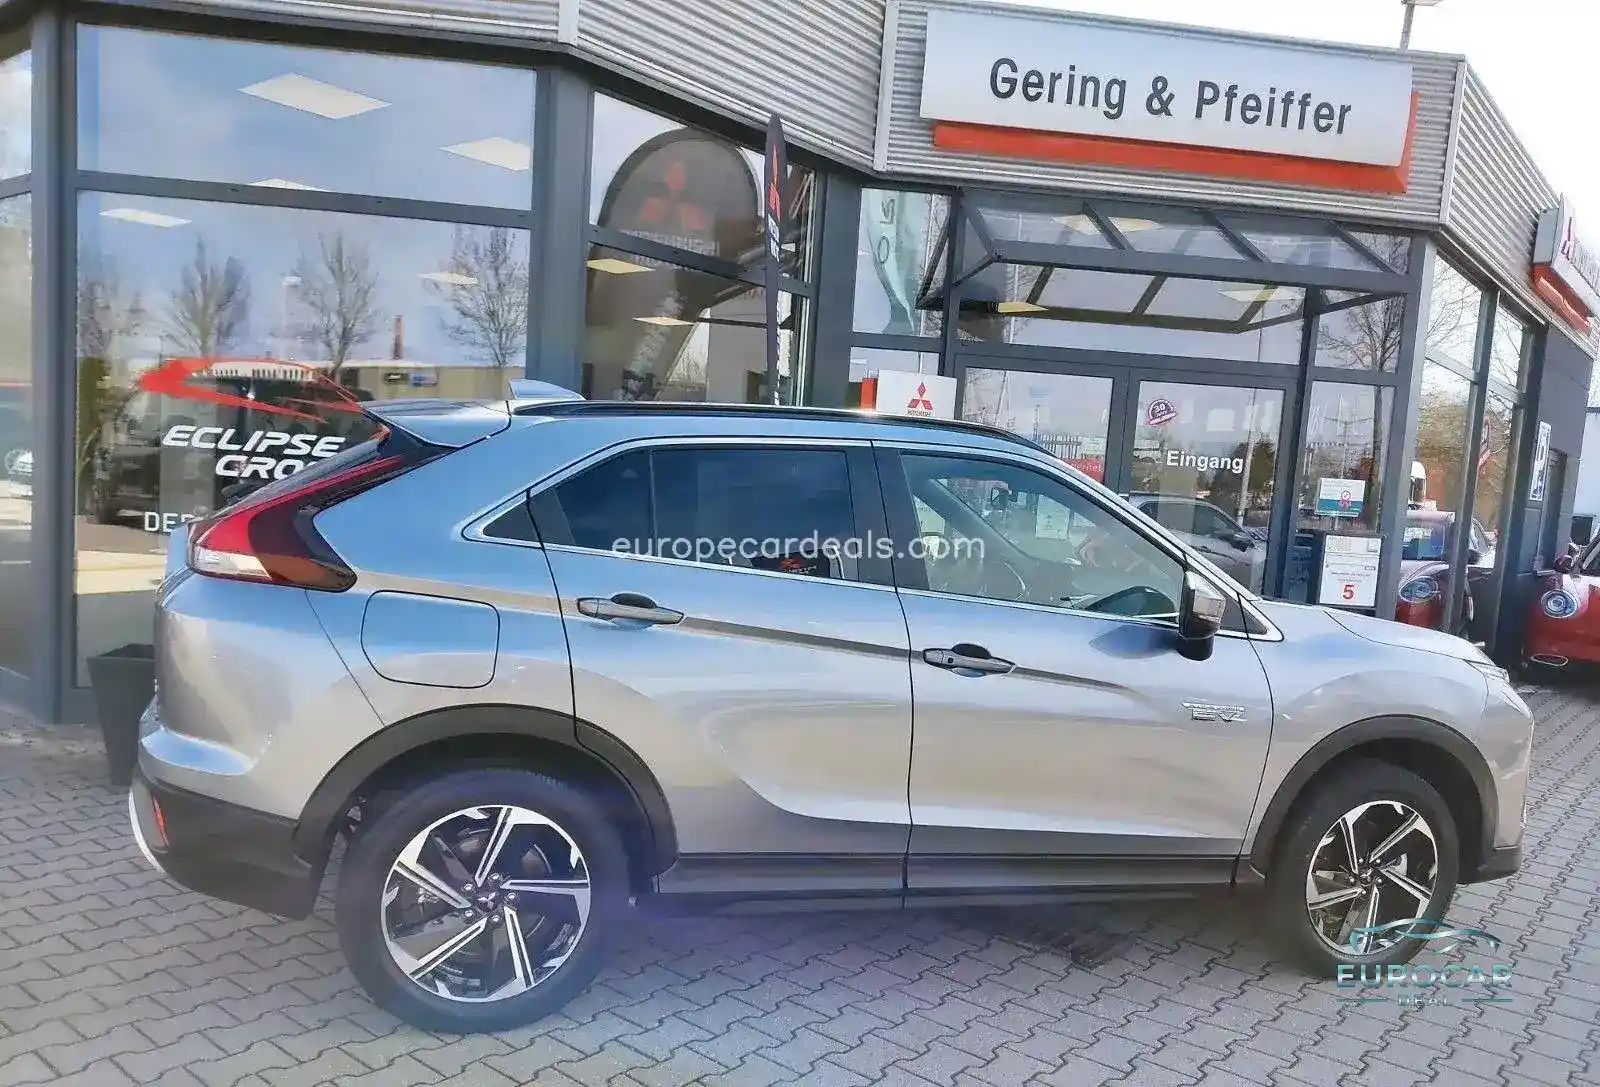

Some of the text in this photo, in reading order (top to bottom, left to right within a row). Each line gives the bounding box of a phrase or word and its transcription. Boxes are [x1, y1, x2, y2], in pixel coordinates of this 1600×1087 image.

[988, 57, 1353, 135] Gering & Pfeiffer
[162, 425, 346, 458] ECLIPSE
[215, 454, 315, 481] CRO
[1166, 449, 1244, 475] Eingang
[1342, 584, 1355, 600] 5
